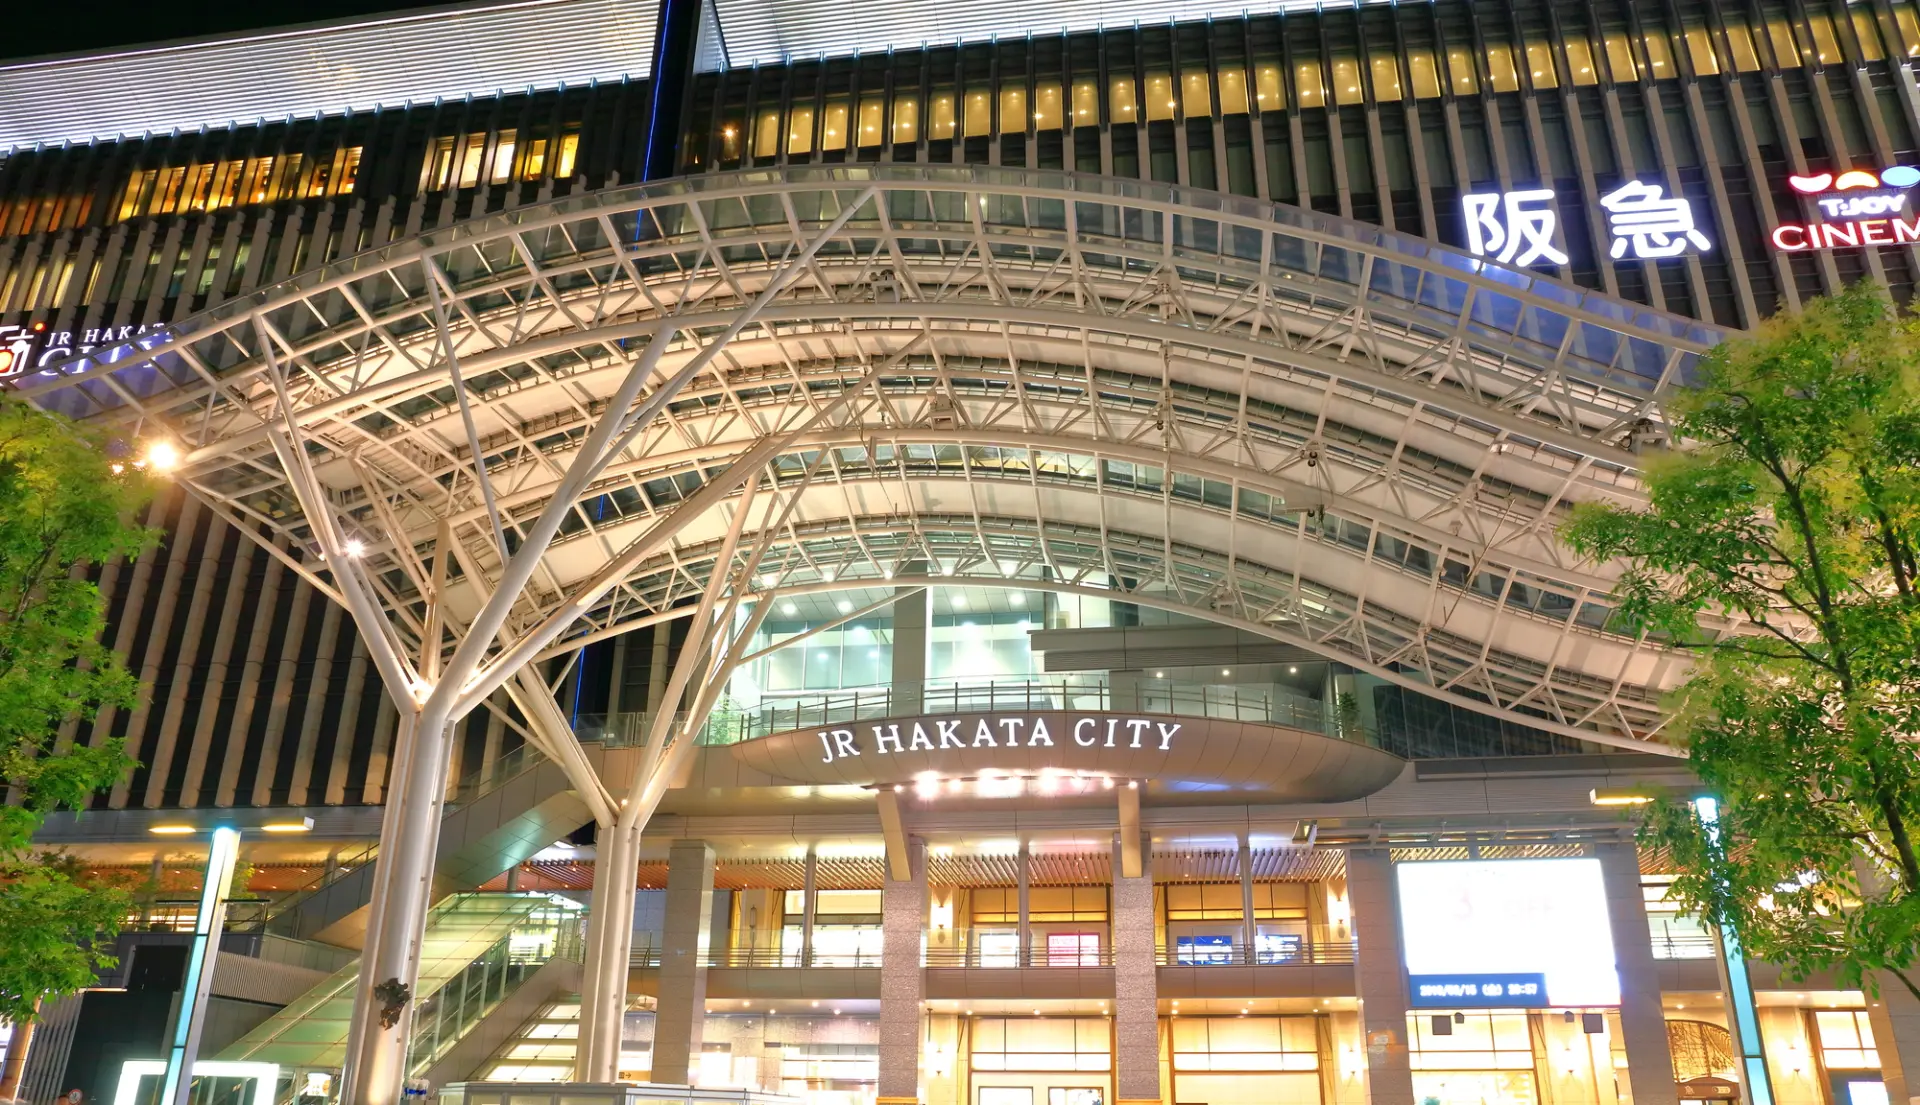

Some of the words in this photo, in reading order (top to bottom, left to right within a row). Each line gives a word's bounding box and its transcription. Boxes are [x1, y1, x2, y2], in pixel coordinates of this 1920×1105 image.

[1462, 180, 1711, 268] 阪急
[45, 331, 71, 347] JR
[84, 322, 170, 343] HAKAT
[817, 729, 861, 763] JR
[872, 717, 1054, 754] HAKATA
[1074, 718, 1181, 750] CITY
